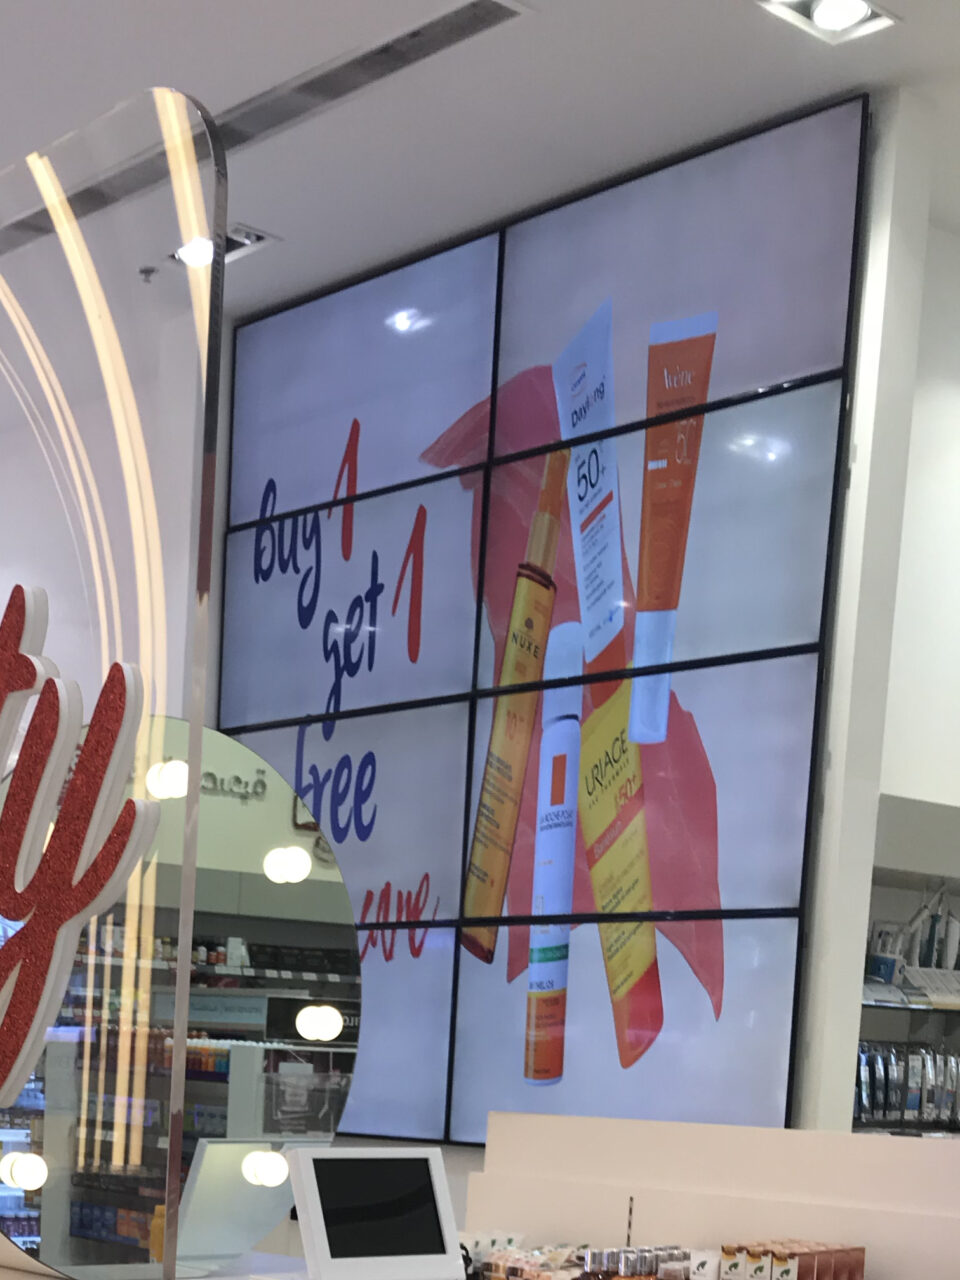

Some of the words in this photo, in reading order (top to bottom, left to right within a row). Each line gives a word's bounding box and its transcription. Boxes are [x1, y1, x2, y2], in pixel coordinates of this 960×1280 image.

[254, 478, 322, 630] buy
[327, 417, 361, 562] 1
[323, 549, 385, 741] get
[392, 503, 427, 664] 1
[511, 631, 541, 659] NUXE
[294, 713, 378, 844] free
[585, 728, 628, 797] URIAGE
